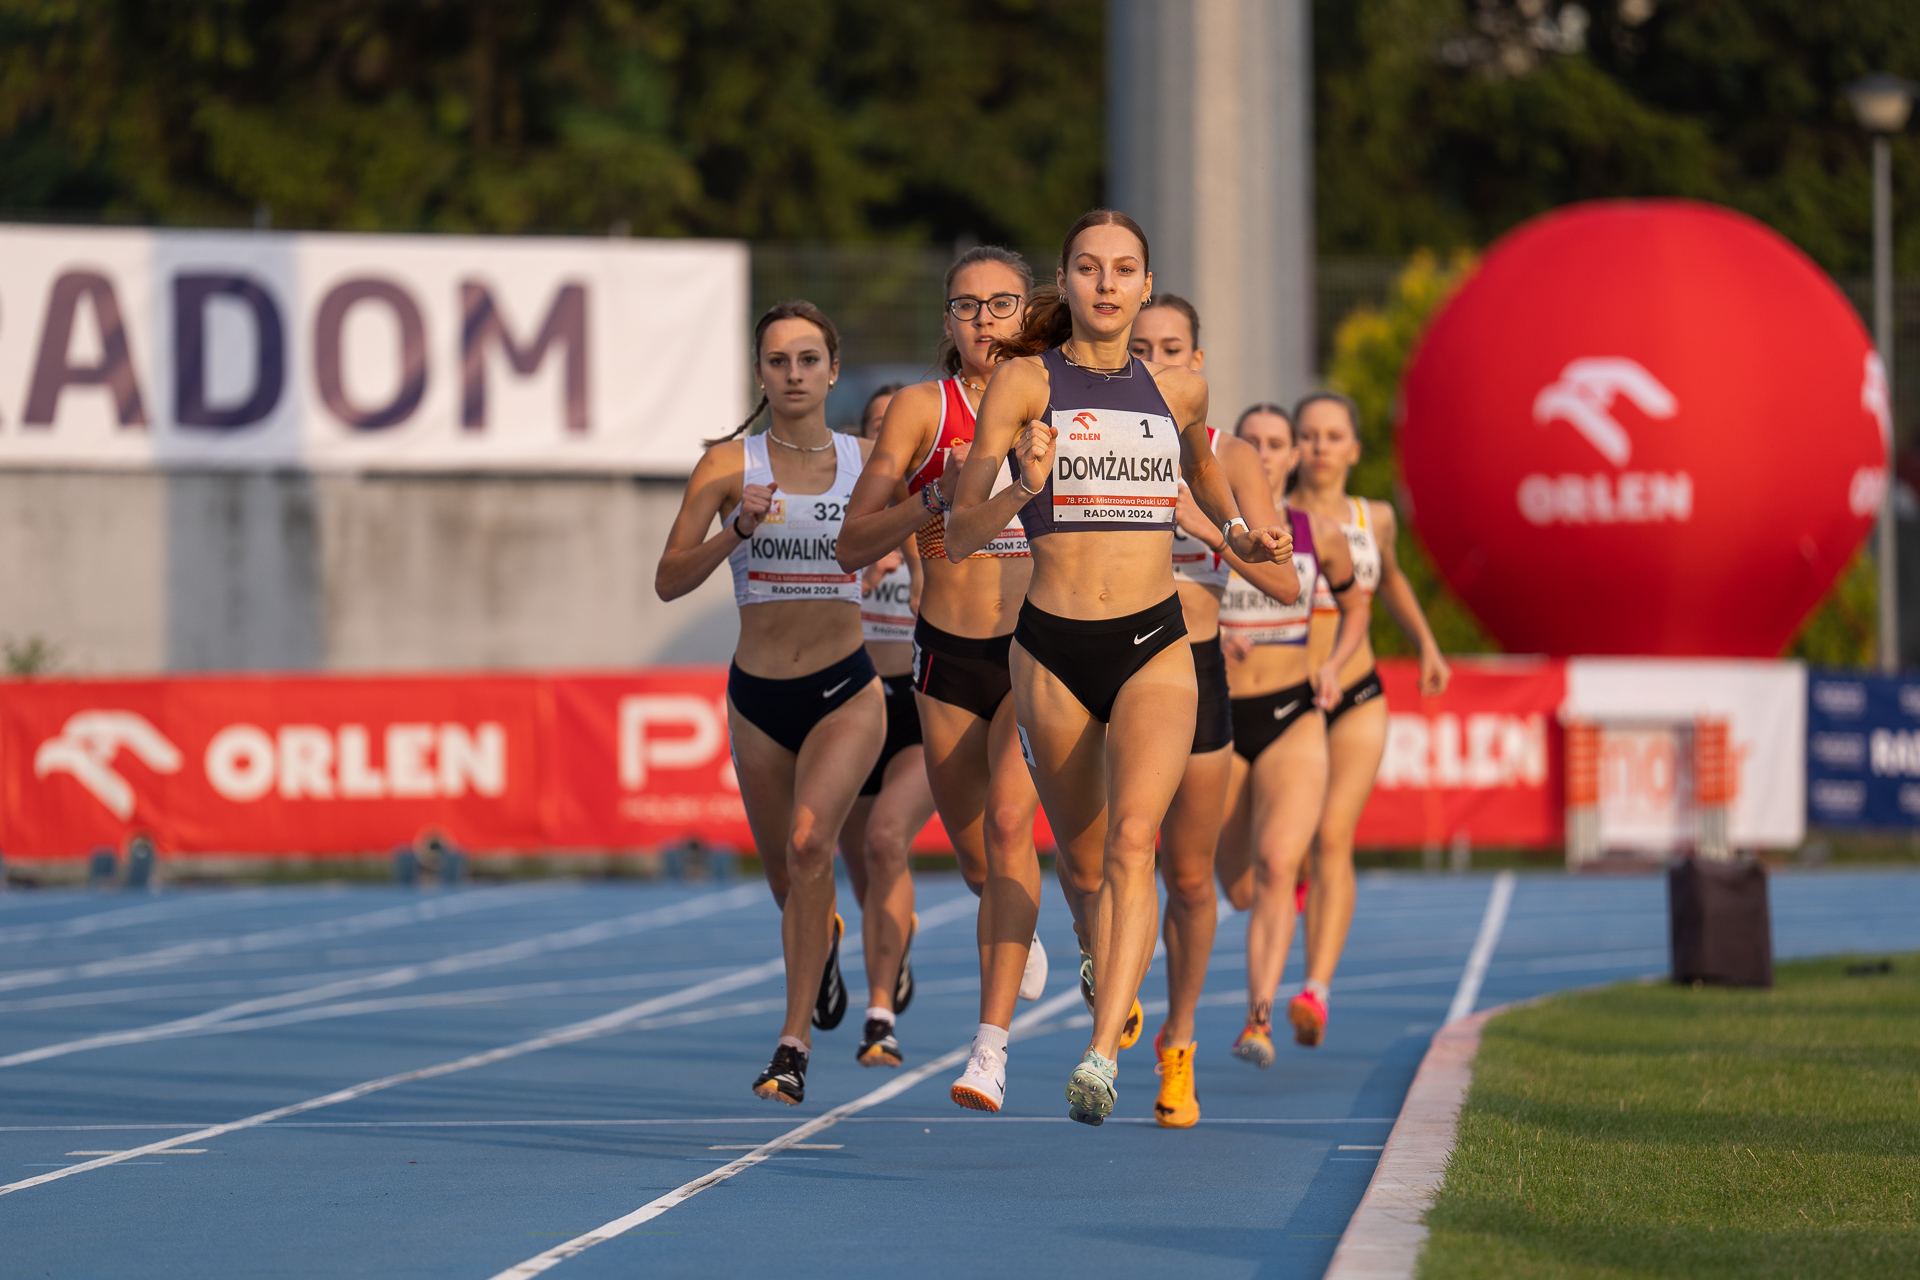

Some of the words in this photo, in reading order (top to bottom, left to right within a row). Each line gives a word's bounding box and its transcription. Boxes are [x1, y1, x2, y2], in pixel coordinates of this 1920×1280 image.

[2, 262, 593, 434] ADOM
[1069, 432, 1101, 441] ORLEN
[1139, 418, 1154, 439] 1
[1058, 450, 1175, 483] DOMŻALSKA
[1066, 496, 1077, 504] 78.
[1096, 497, 1136, 505] Mistrzostwa
[1157, 498, 1170, 506] U20
[1517, 470, 1694, 528] ORLEN
[814, 502, 847, 521] 32
[1083, 509, 1126, 518] RADOM
[1128, 510, 1154, 519] 2024
[981, 541, 1014, 551] ADOM
[771, 585, 812, 595] RADOM
[814, 586, 839, 595] 2024
[618, 693, 738, 791] P
[1377, 711, 1549, 790] RLEN
[203, 720, 508, 804] ORLEN
